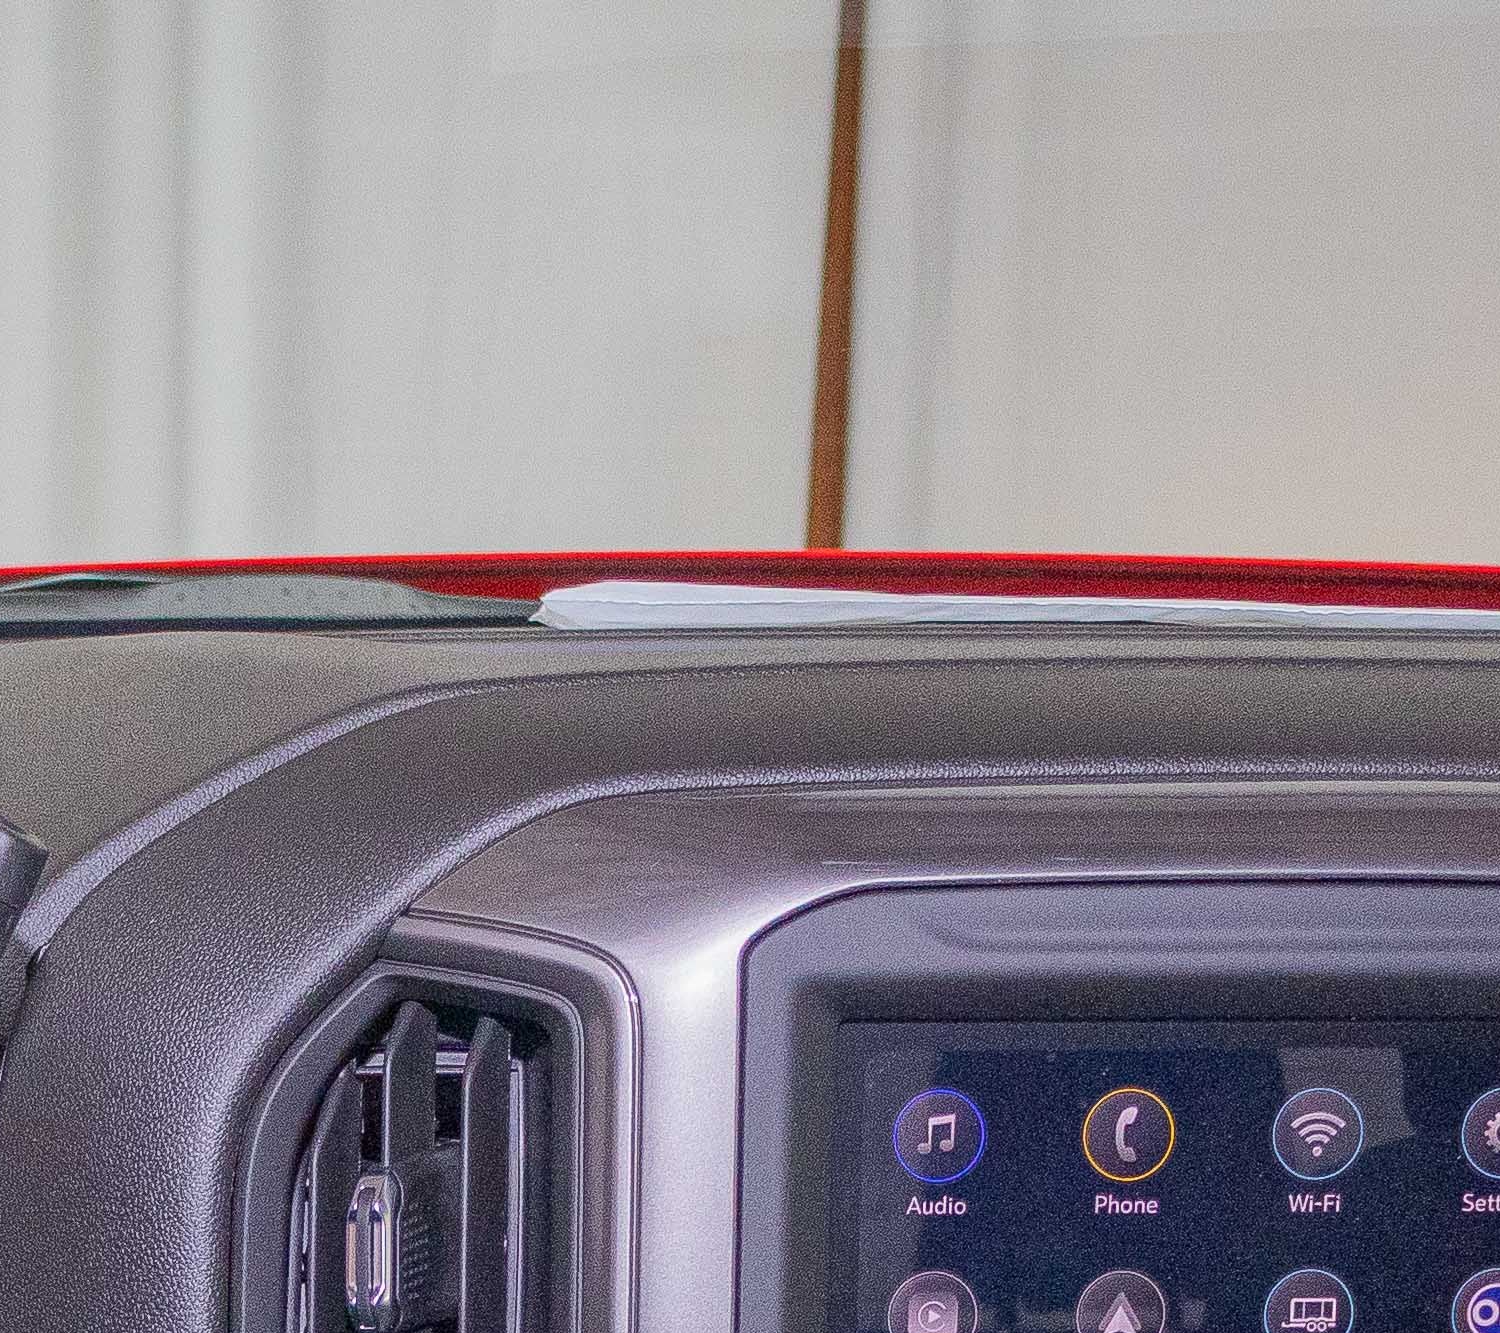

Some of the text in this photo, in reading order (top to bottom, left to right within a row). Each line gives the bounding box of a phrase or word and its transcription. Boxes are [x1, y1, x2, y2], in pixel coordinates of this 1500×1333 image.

[906, 1197, 967, 1216] Audio
[1094, 1195, 1159, 1214] Phone
[1289, 1193, 1342, 1213] Wi-Fi
